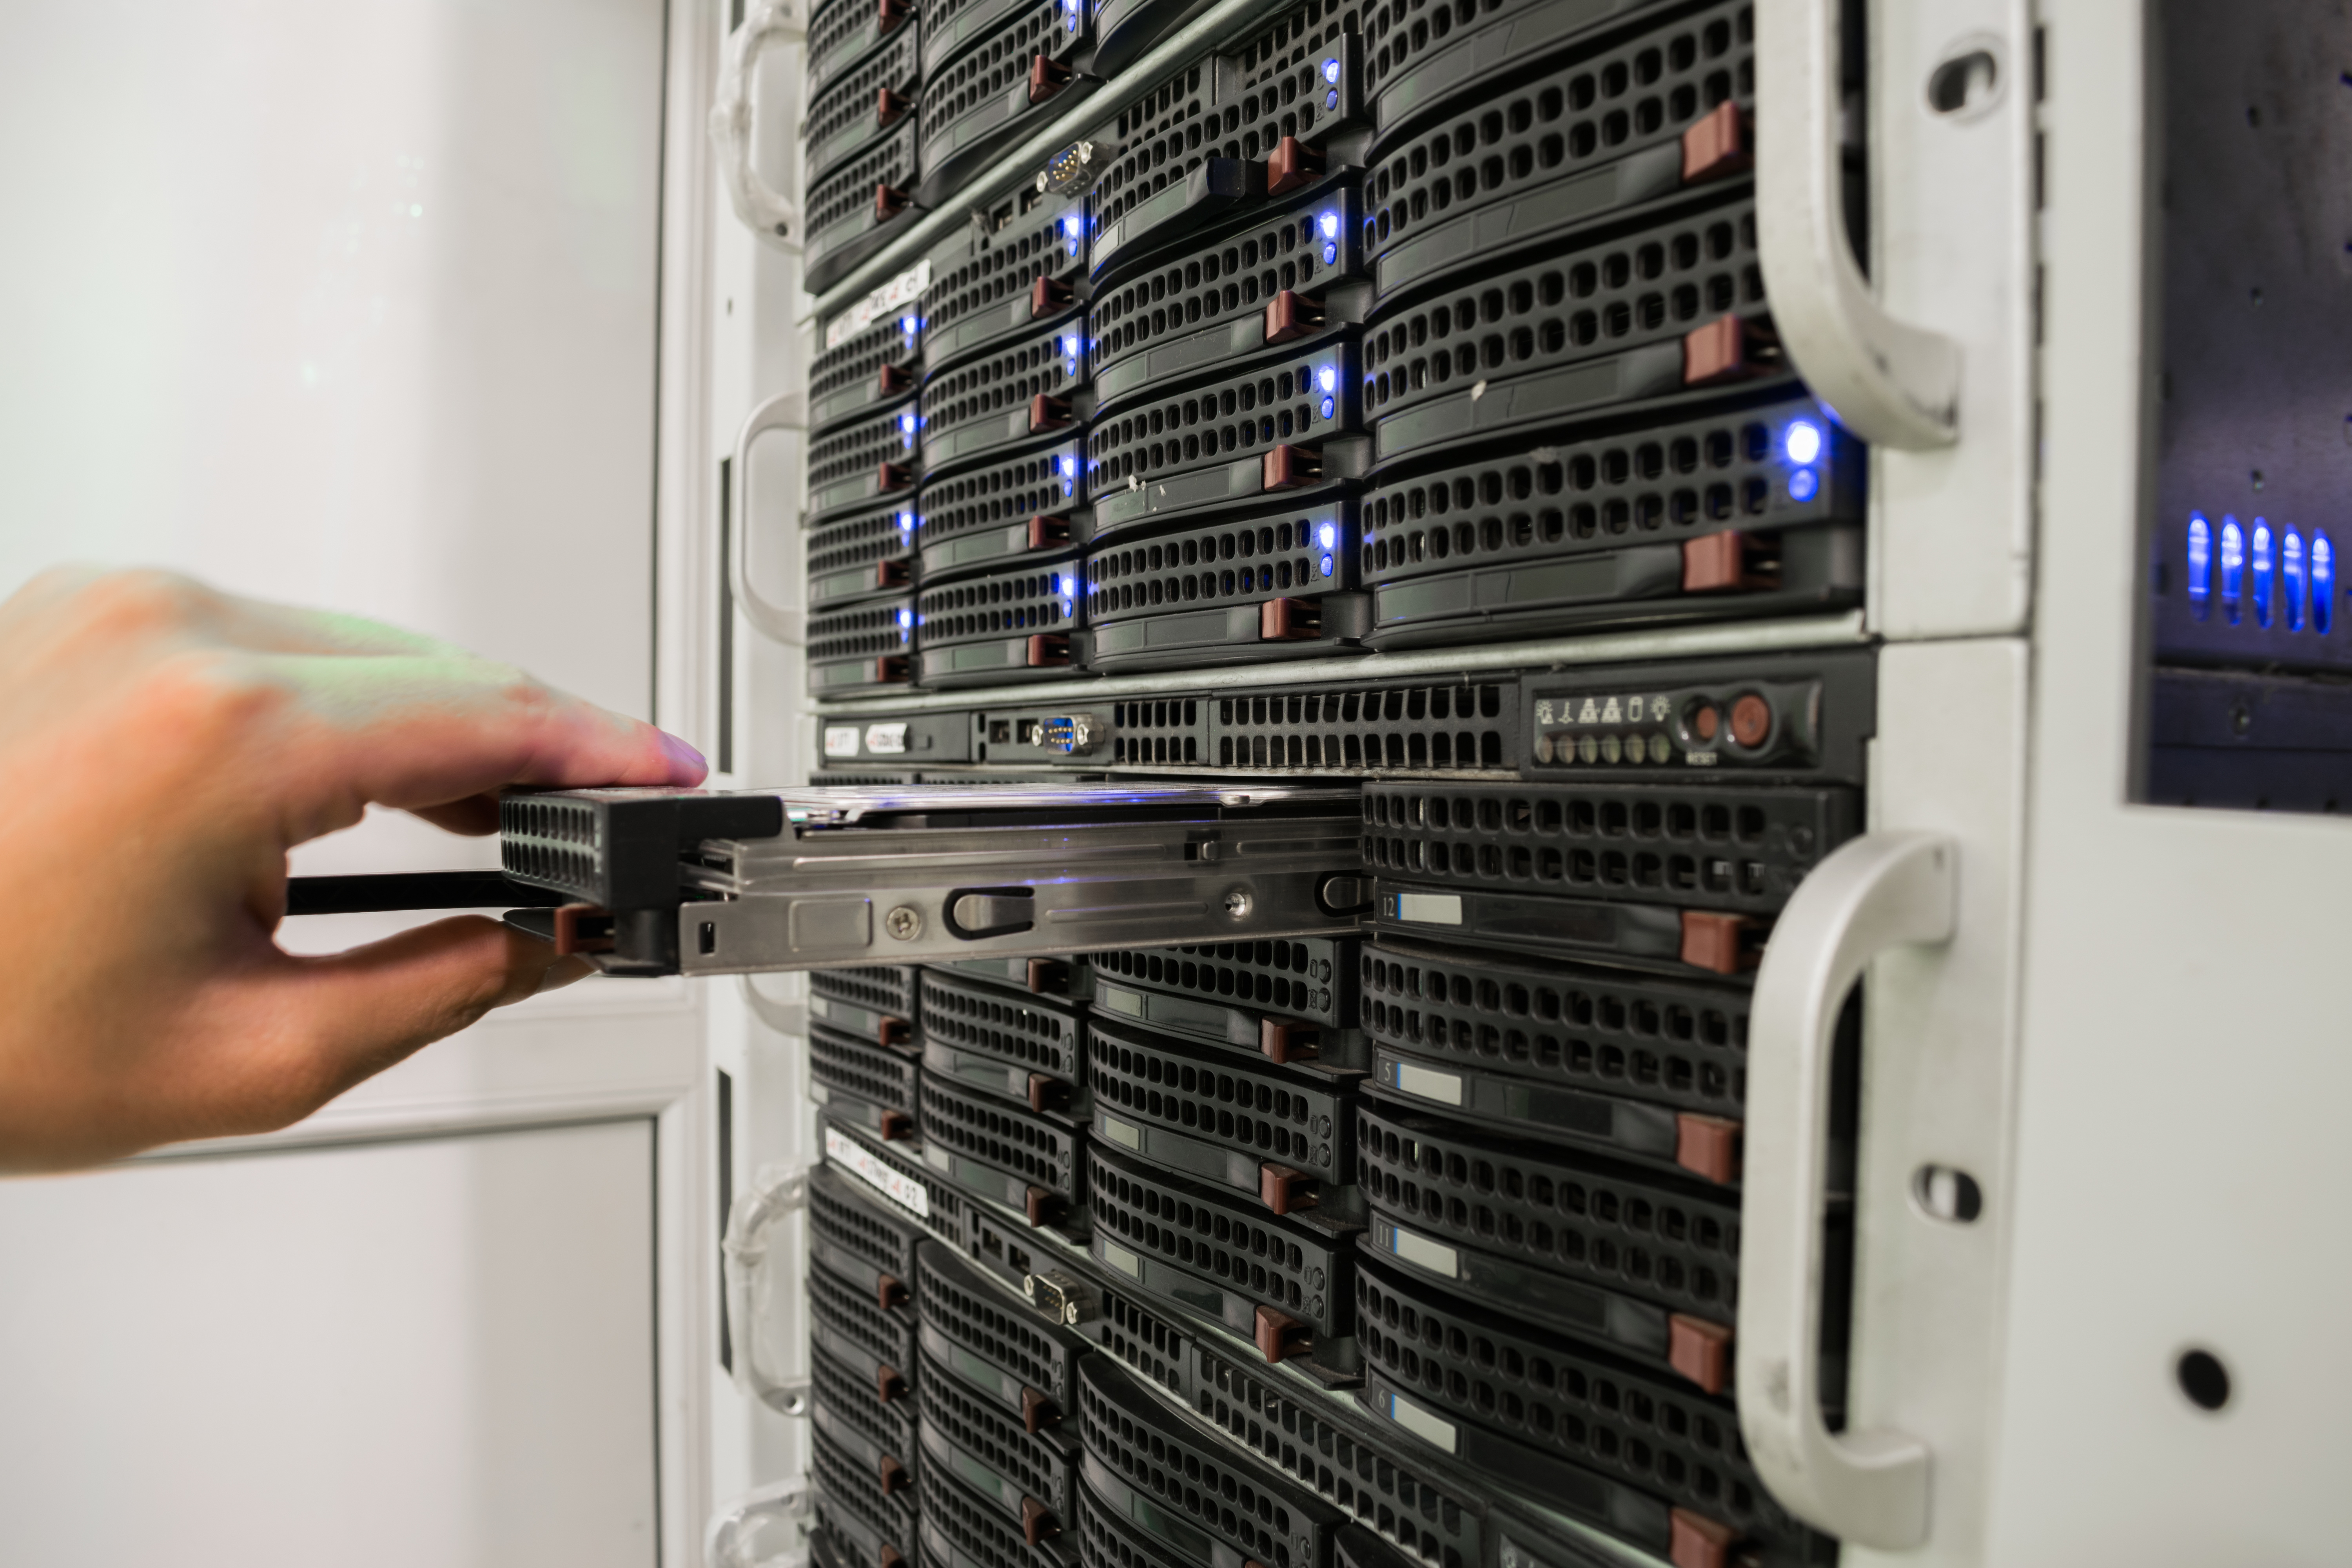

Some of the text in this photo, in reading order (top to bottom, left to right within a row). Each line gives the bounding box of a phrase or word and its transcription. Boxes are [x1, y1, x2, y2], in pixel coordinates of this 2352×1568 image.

[1686, 752, 1717, 766] RESET
[1383, 896, 1394, 917] 12
[1384, 1062, 1390, 1082] 5
[1379, 1225, 1389, 1247] 11
[1378, 1389, 1385, 1408] 6
